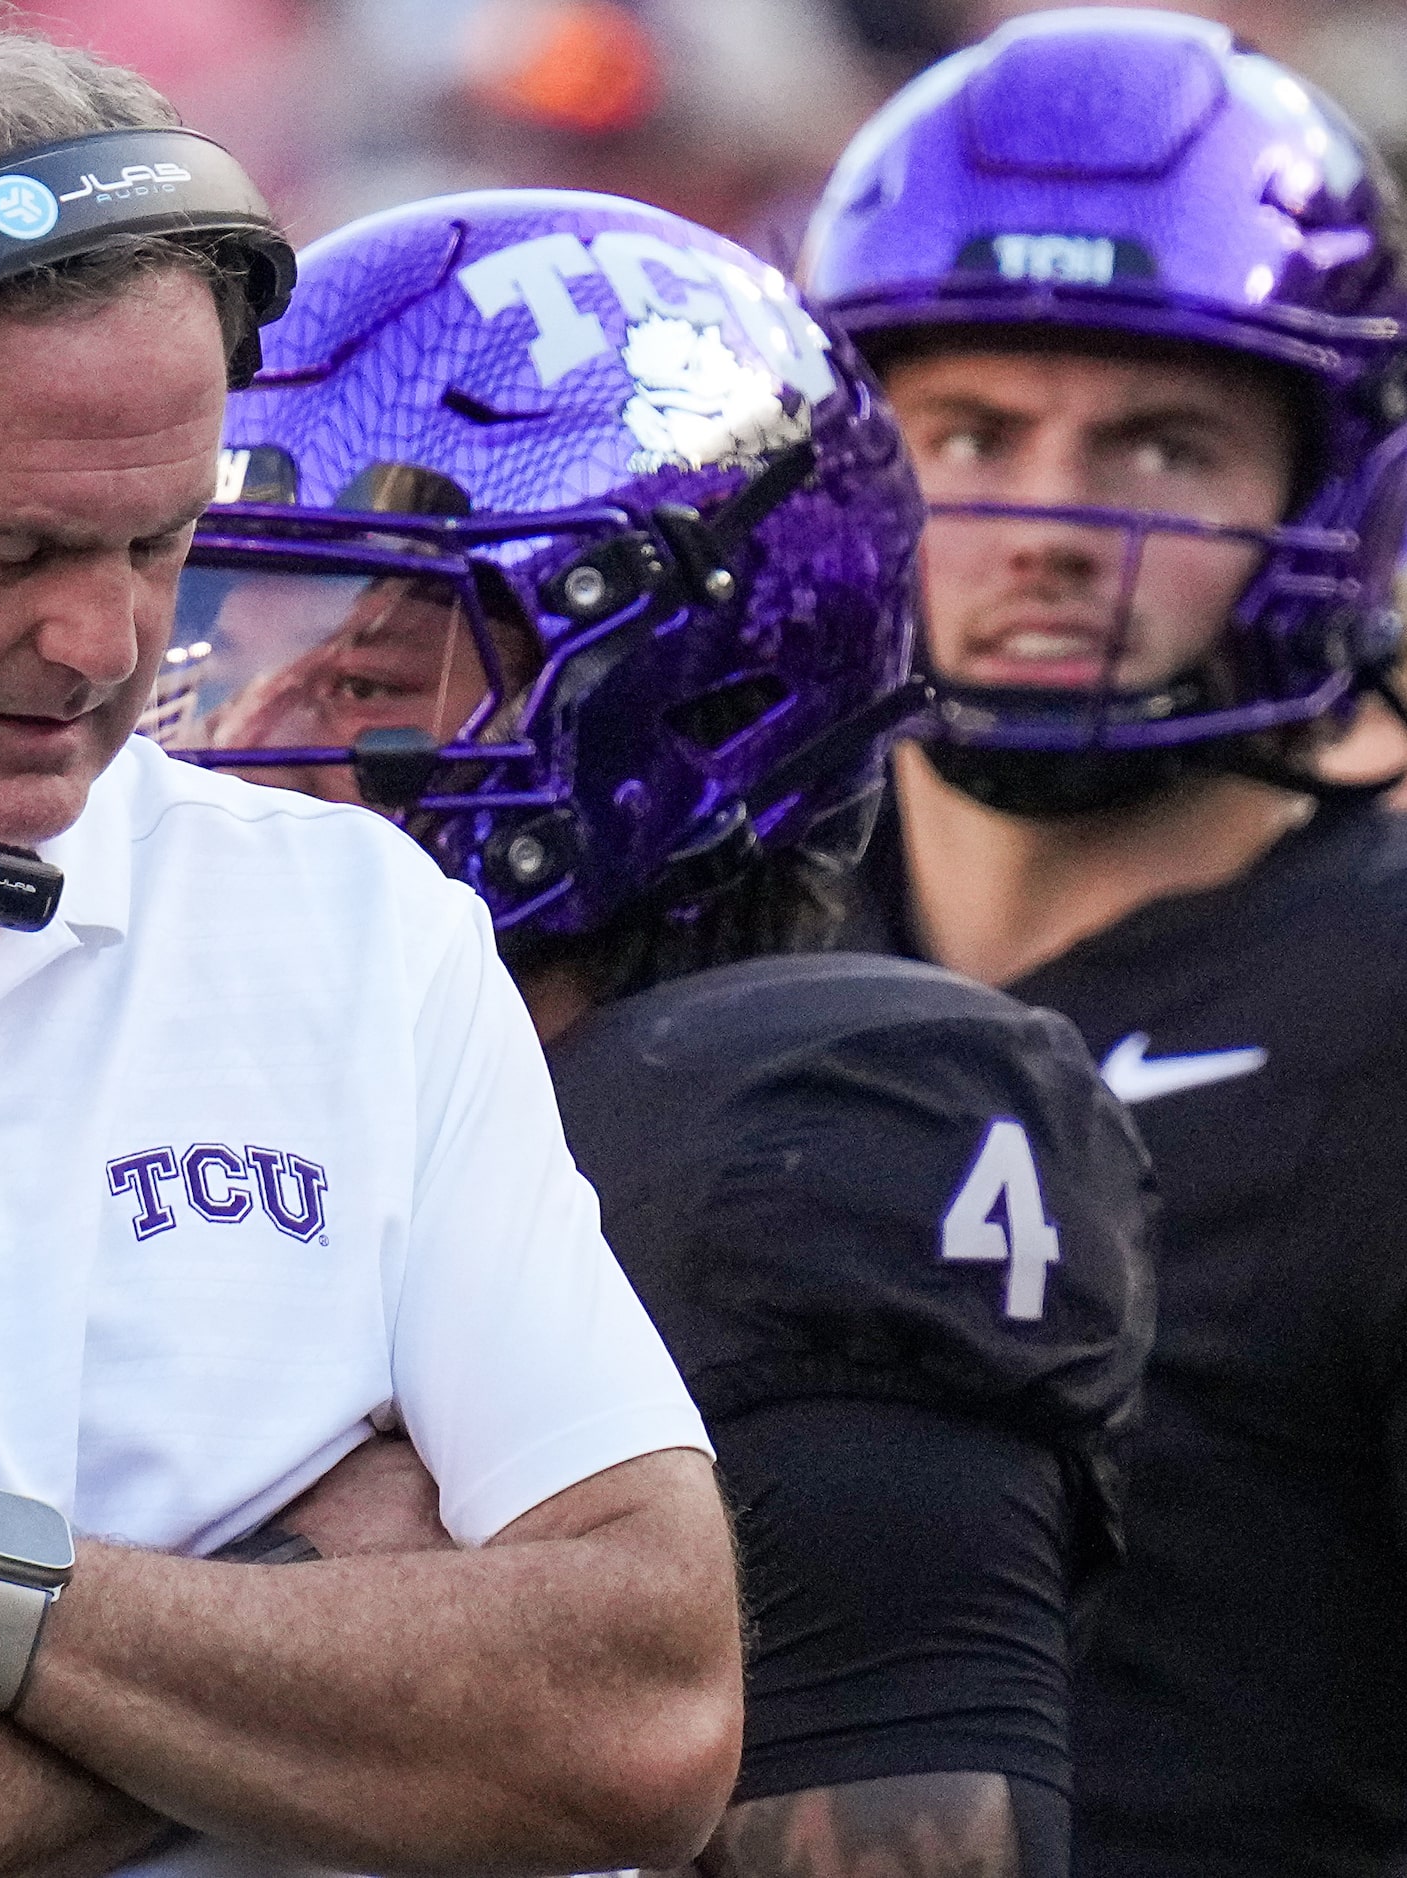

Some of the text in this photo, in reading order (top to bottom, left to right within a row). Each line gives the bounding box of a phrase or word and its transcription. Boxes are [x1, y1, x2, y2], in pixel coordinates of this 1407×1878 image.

[96, 184, 176, 204] AUDIO
[458, 230, 836, 406] TCU
[105, 1143, 329, 1245] TCU
[940, 1115, 1063, 1321] 4
